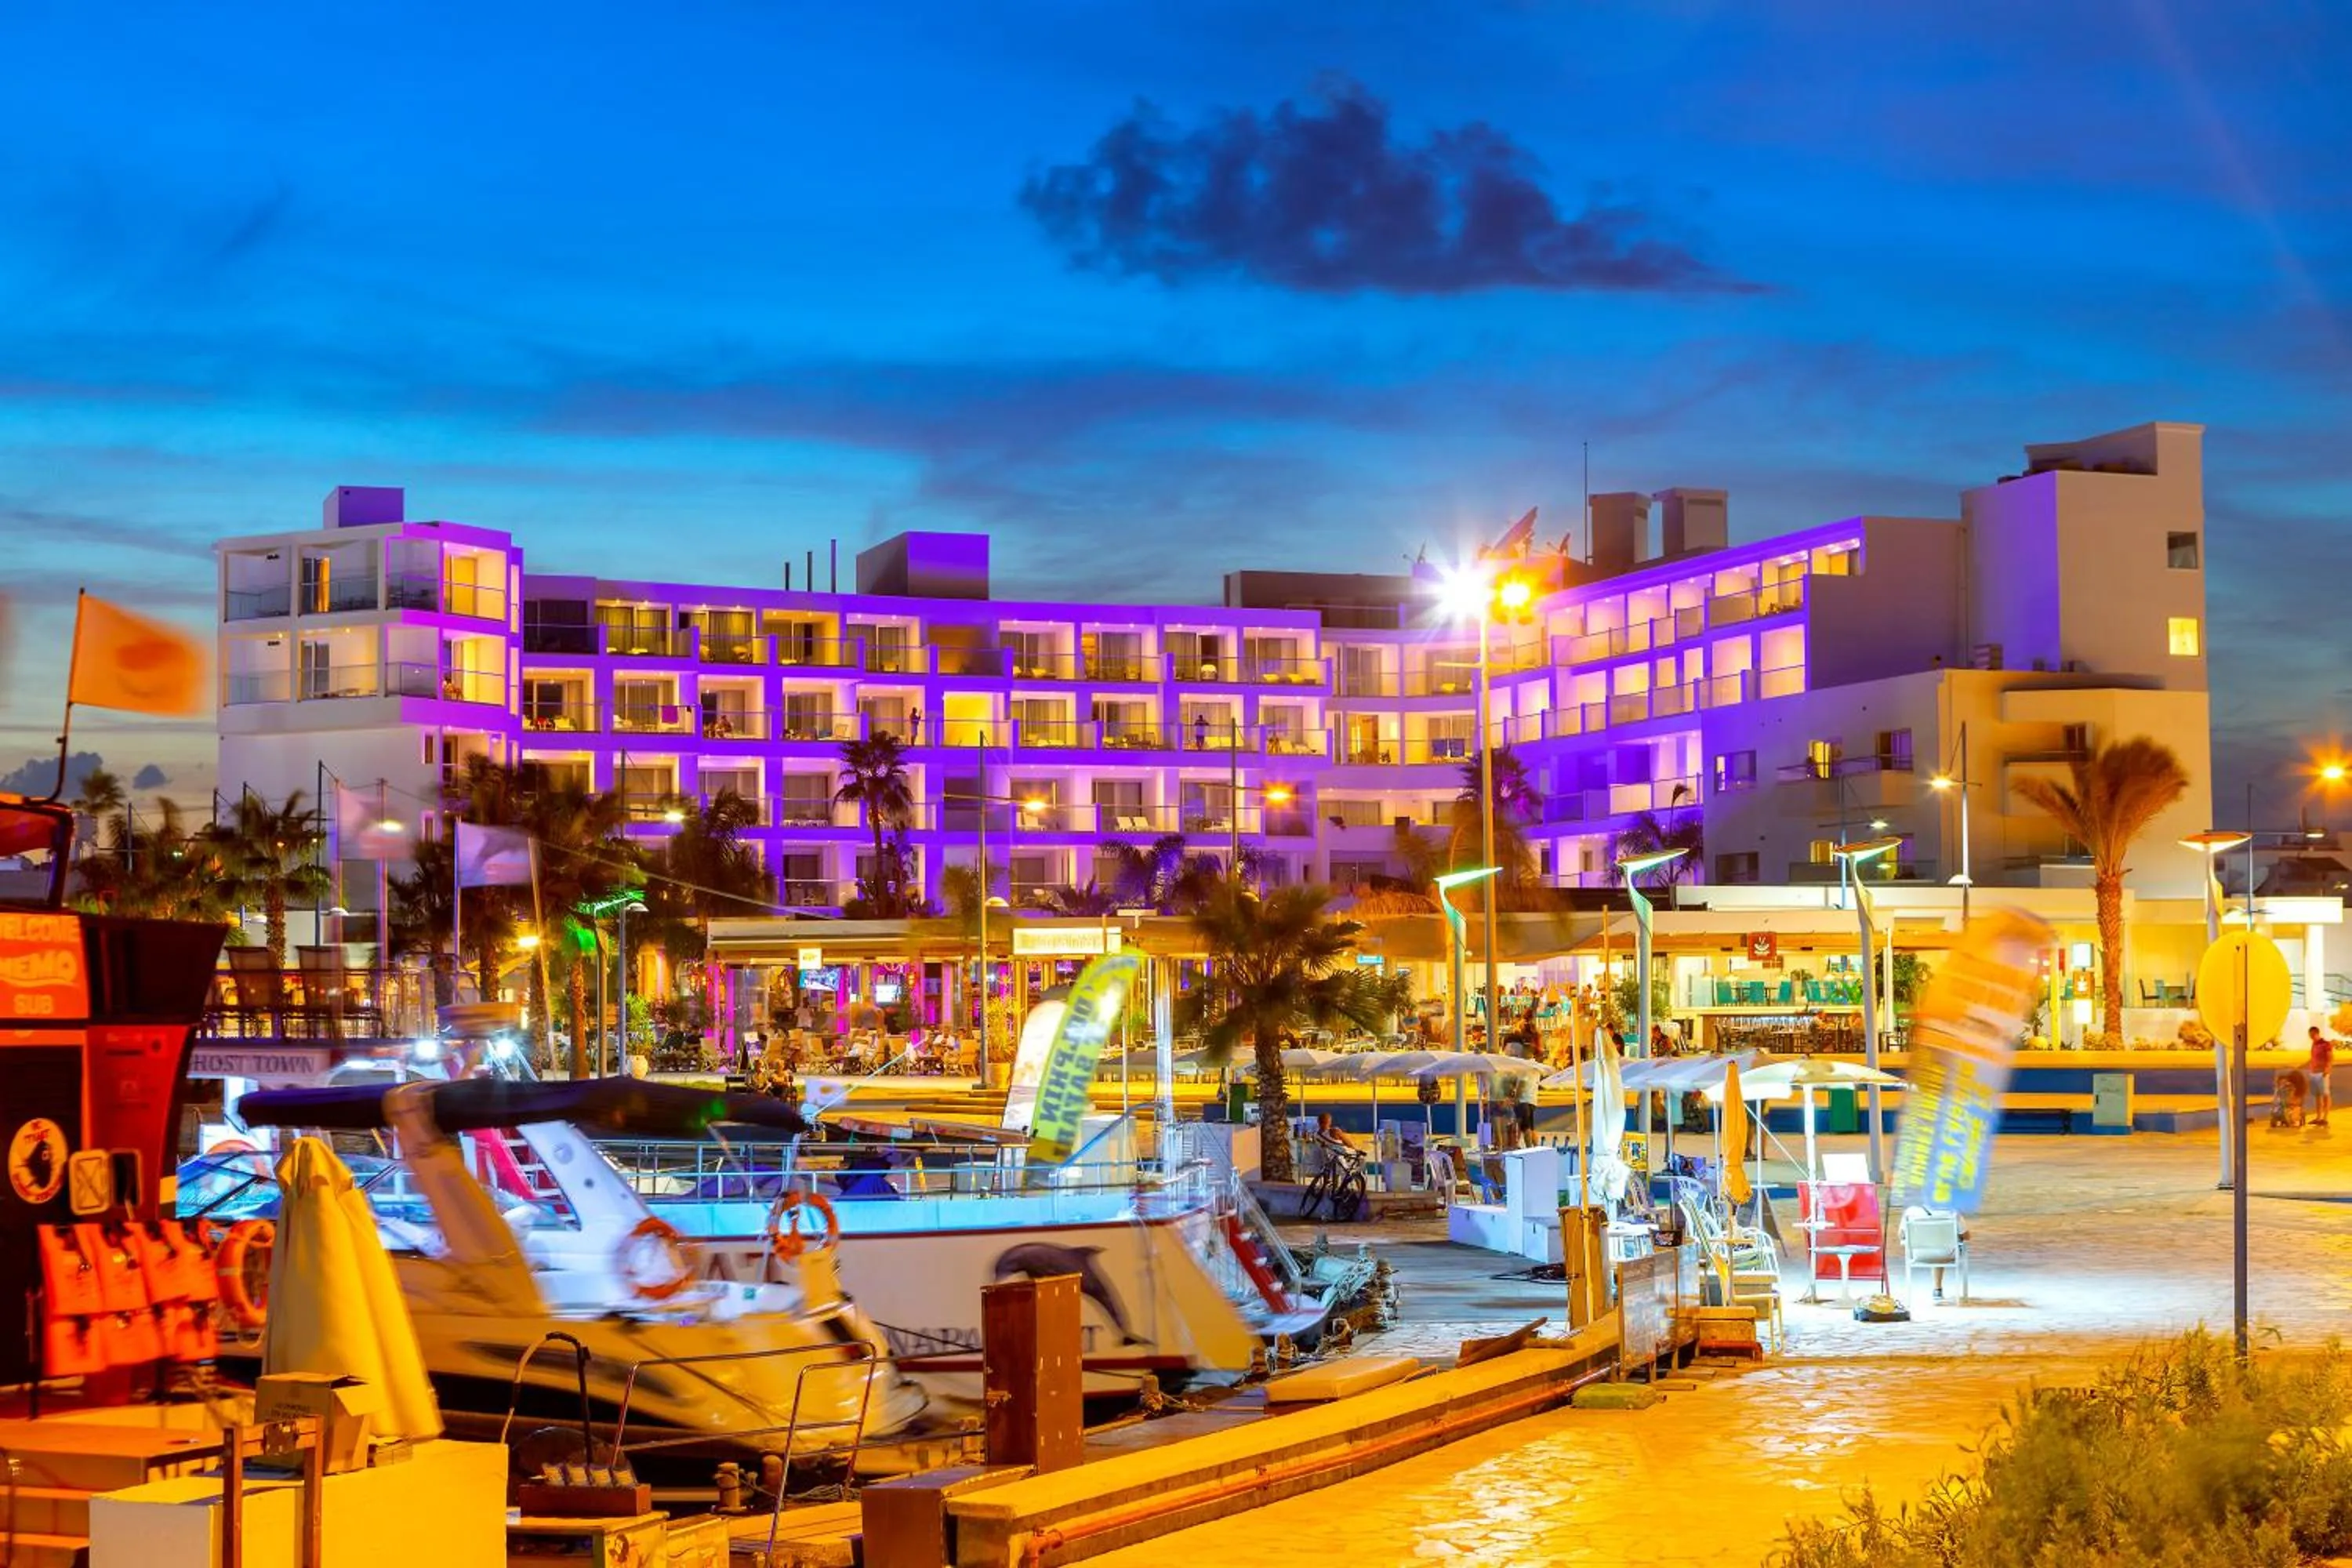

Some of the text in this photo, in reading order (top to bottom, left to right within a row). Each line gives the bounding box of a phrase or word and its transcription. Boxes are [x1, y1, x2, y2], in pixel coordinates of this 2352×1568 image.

[0, 916, 80, 942] ELCOME
[13, 994, 54, 1014] SUB
[252, 1055, 314, 1073] TOWN
